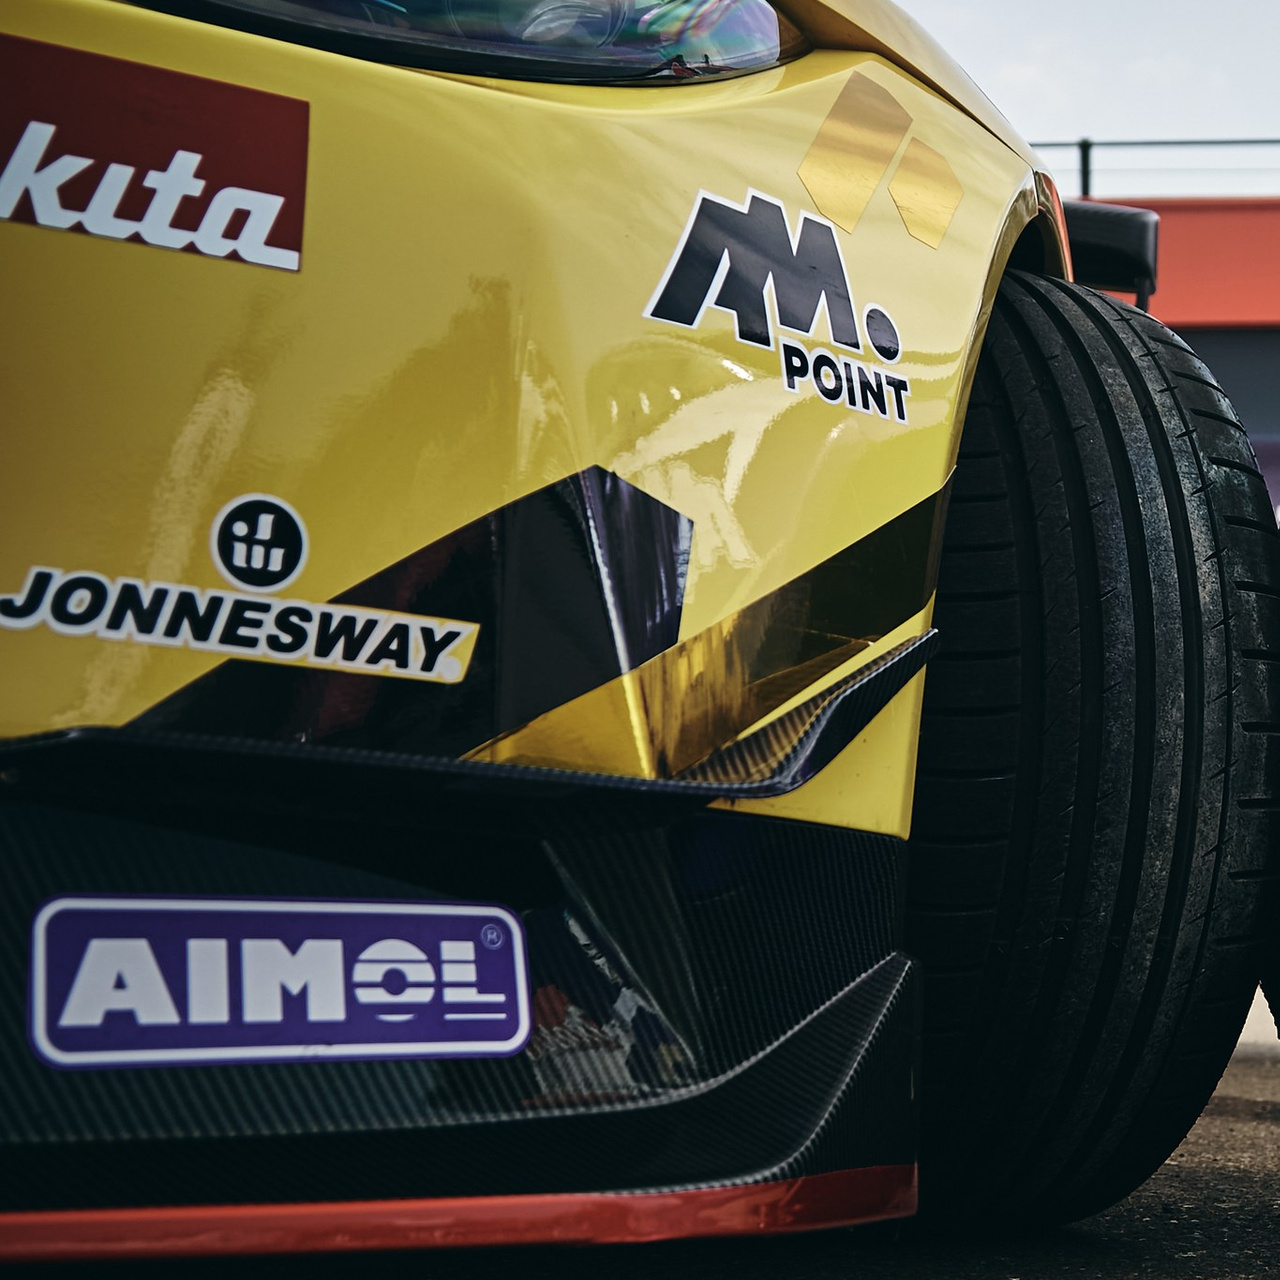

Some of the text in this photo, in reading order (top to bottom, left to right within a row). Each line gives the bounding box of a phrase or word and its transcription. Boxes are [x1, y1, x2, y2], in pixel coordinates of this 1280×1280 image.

[783, 342, 908, 421] POINT
[0, 571, 461, 673] JONNESWAY
[58, 938, 507, 1026] AIMOL
